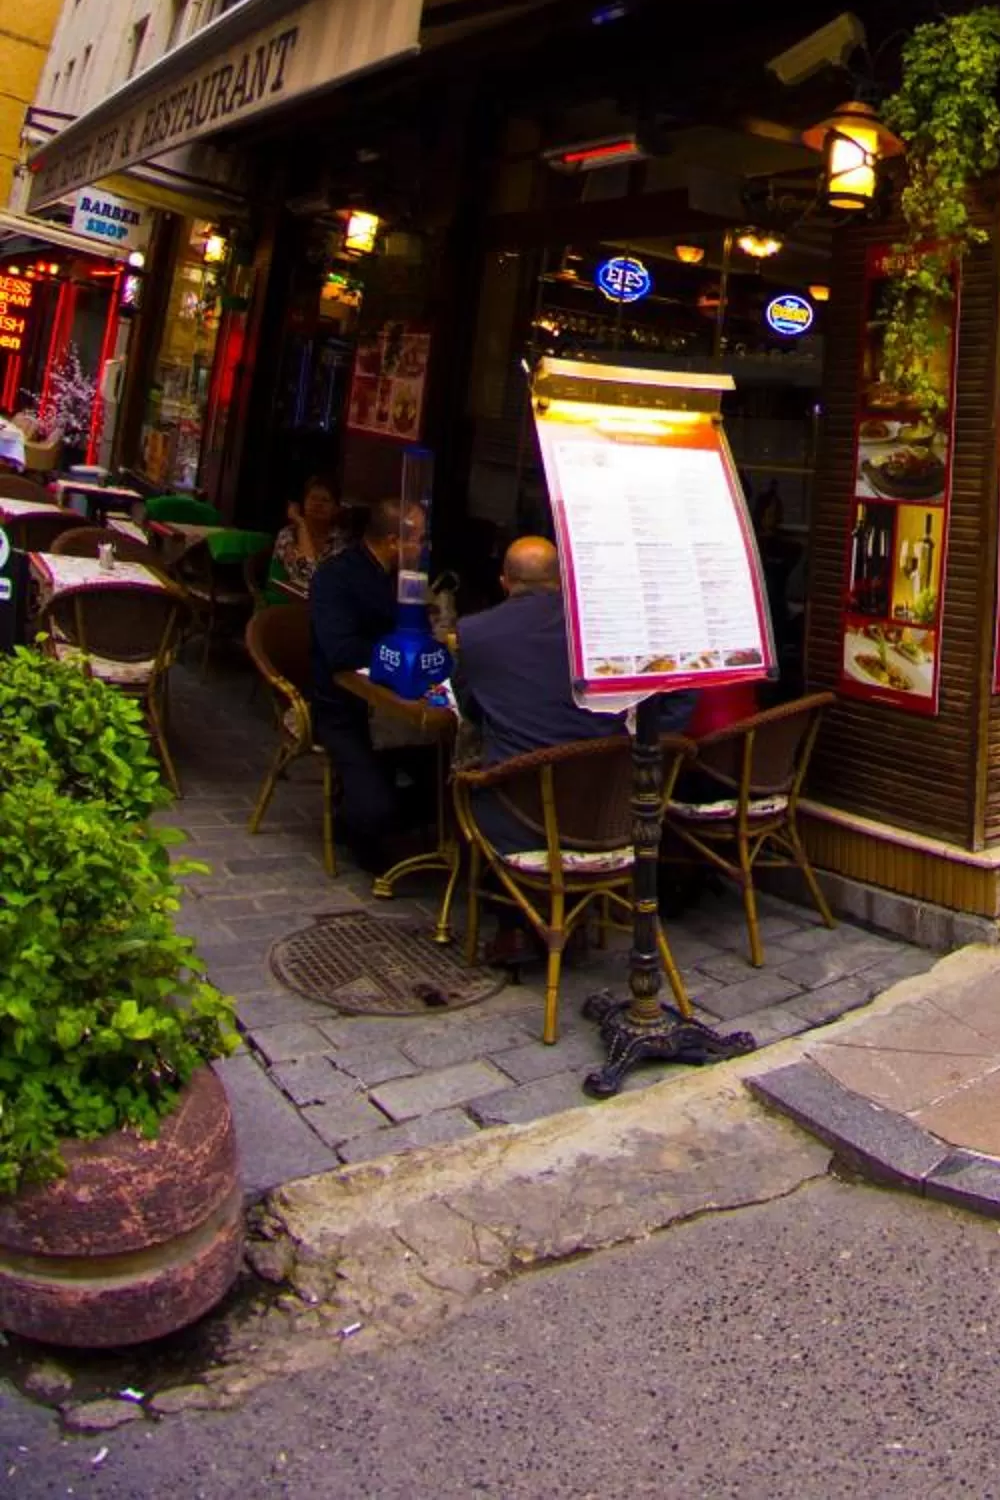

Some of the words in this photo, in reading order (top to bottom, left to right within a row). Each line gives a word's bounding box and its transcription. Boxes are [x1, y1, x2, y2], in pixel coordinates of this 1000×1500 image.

[138, 27, 298, 153] RESTAURANT
[80, 197, 140, 226] BARBER
[85, 218, 129, 240] SHOP
[420, 649, 445, 669] EFES
